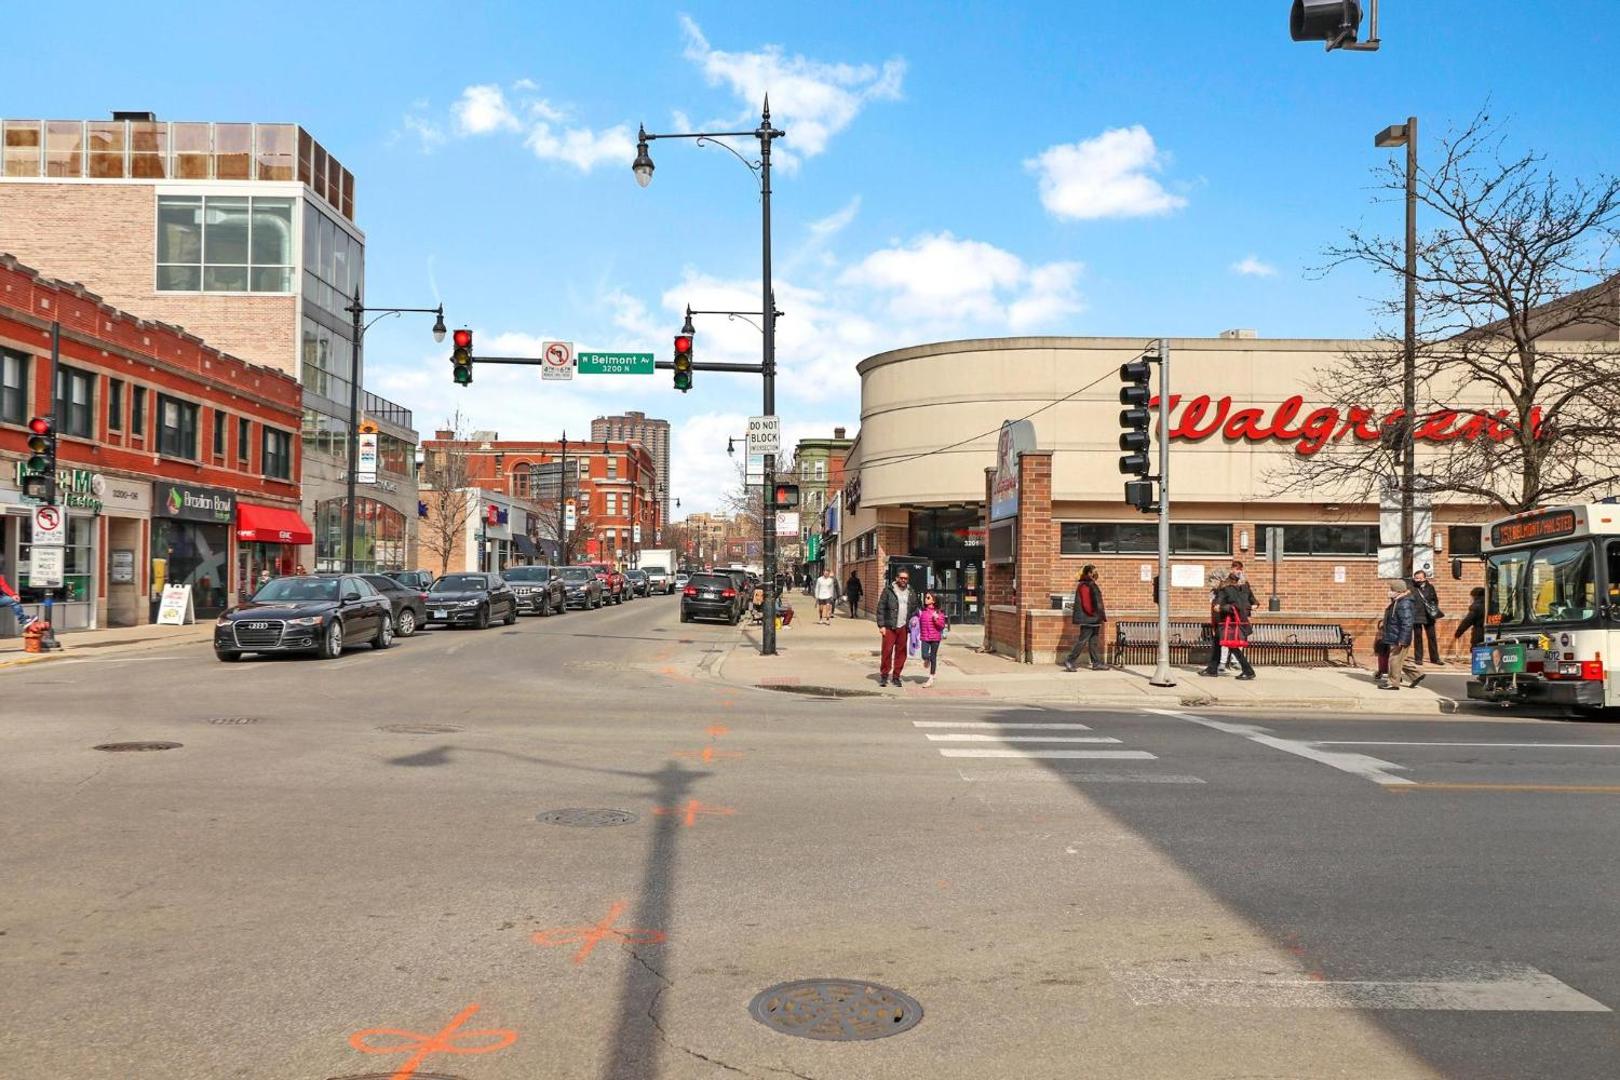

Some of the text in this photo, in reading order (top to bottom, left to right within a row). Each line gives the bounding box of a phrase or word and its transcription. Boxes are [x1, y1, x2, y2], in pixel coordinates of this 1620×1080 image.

[591, 355, 637, 365] Belmont
[641, 356, 650, 364] Av
[602, 365, 622, 373] 3200
[750, 420, 778, 431] DO NOT
[751, 432, 778, 443] BLOCK
[214, 495, 231, 512] Bowl
[1544, 650, 1560, 661] 4012
